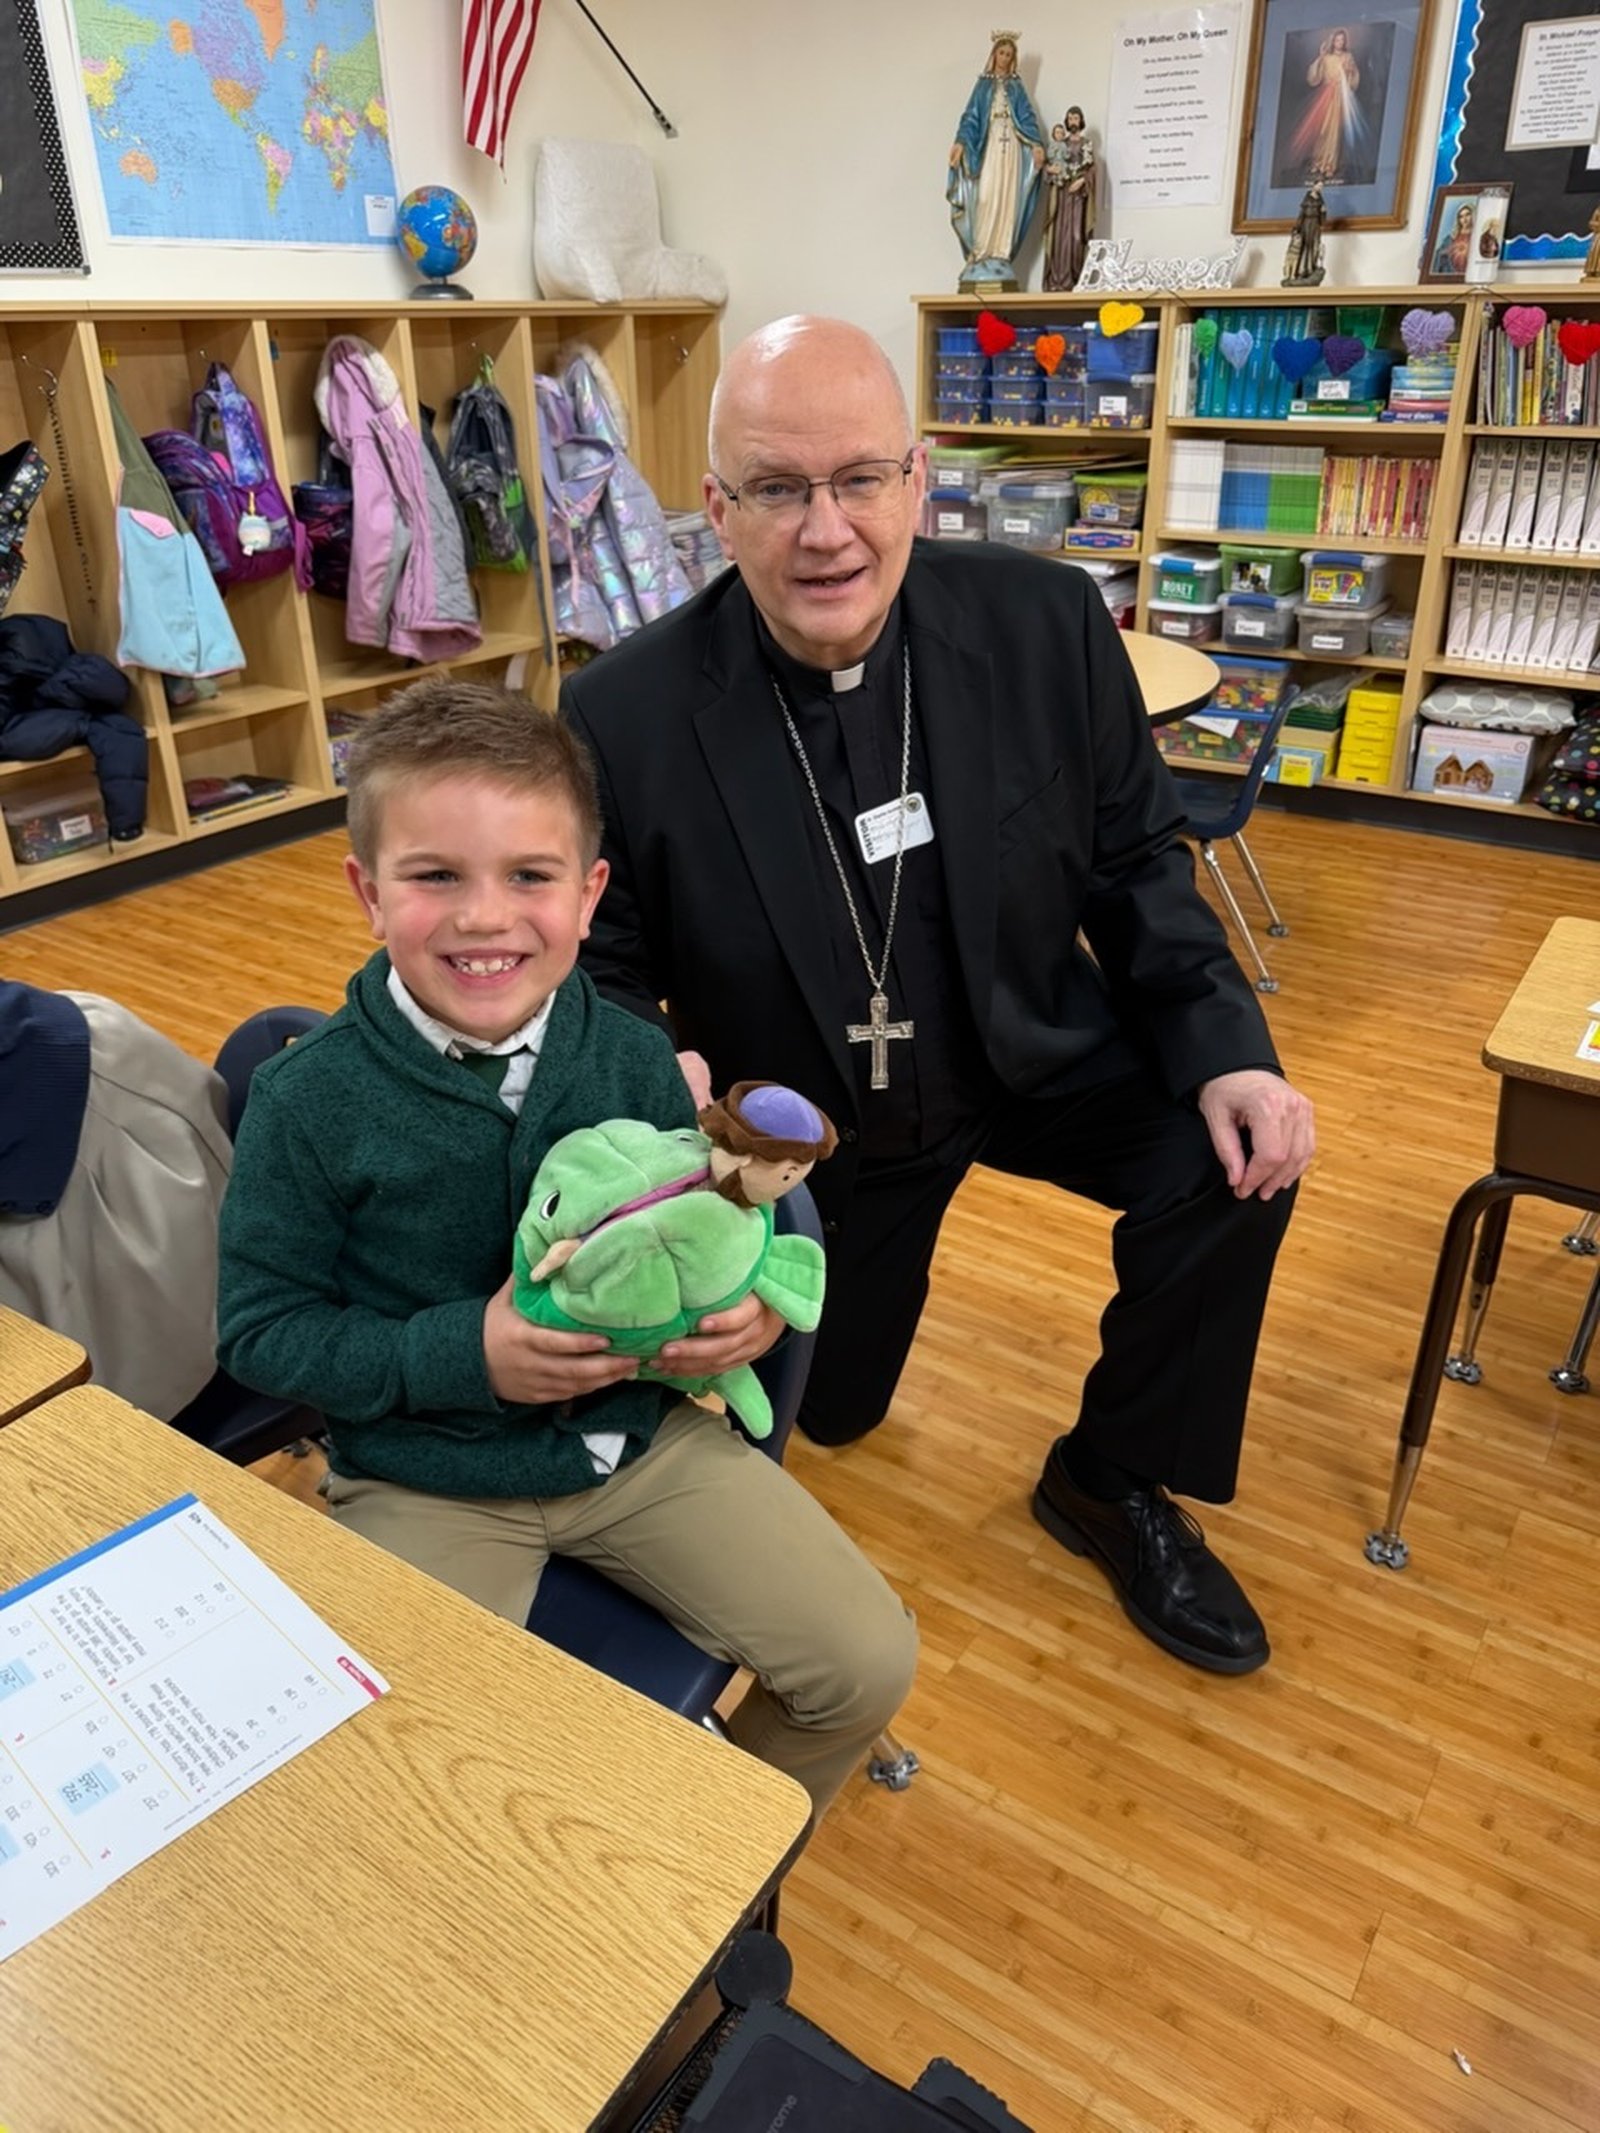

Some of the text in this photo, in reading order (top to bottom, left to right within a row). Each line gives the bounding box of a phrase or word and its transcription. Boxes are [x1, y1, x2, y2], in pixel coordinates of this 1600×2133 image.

[1124, 38, 1134, 47] Oh
[1137, 37, 1146, 47] My
[1177, 32, 1188, 41] Oh
[1190, 31, 1202, 40] My
[1204, 29, 1228, 39] Queen
[1549, 30, 1576, 39] Michael
[1073, 235, 1248, 292] Blessed
[56, 1594, 68, 1605] the
[68, 1587, 84, 1603] many
[50, 1607, 60, 1616] on
[69, 1609, 82, 1618] go
[80, 1602, 94, 1616] How
[76, 1617, 96, 1636] people
[80, 1586, 147, 1656] more people go on Tuesday?
[64, 1624, 75, 1635] the
[77, 1639, 89, 1648] go
[116, 1645, 128, 1654] on
[83, 1647, 104, 1667] people
[150, 1683, 166, 1700] these
[163, 1677, 182, 1697] books
[120, 1692, 132, 1704] the
[160, 1699, 174, 1708] of
[178, 1694, 192, 1709] new
[134, 1708, 154, 1729] books
[147, 1702, 167, 1722] Some
[190, 1707, 206, 1726] many
[175, 1714, 190, 1727] out
[147, 1726, 163, 1740] 178
[186, 1725, 205, 1744] check
[204, 1724, 219, 1741] How
[222, 1727, 250, 1752] are left?
[159, 1738, 174, 1754] has
[181, 1742, 202, 1764] books
[170, 1750, 190, 1773] library
[201, 1742, 226, 1768] children
[121, 1769, 138, 1784] 327
[198, 1761, 213, 1777] new
[186, 1770, 200, 1787] The
[62, 1782, 83, 1804] 592
[142, 1796, 160, 1811] 237
